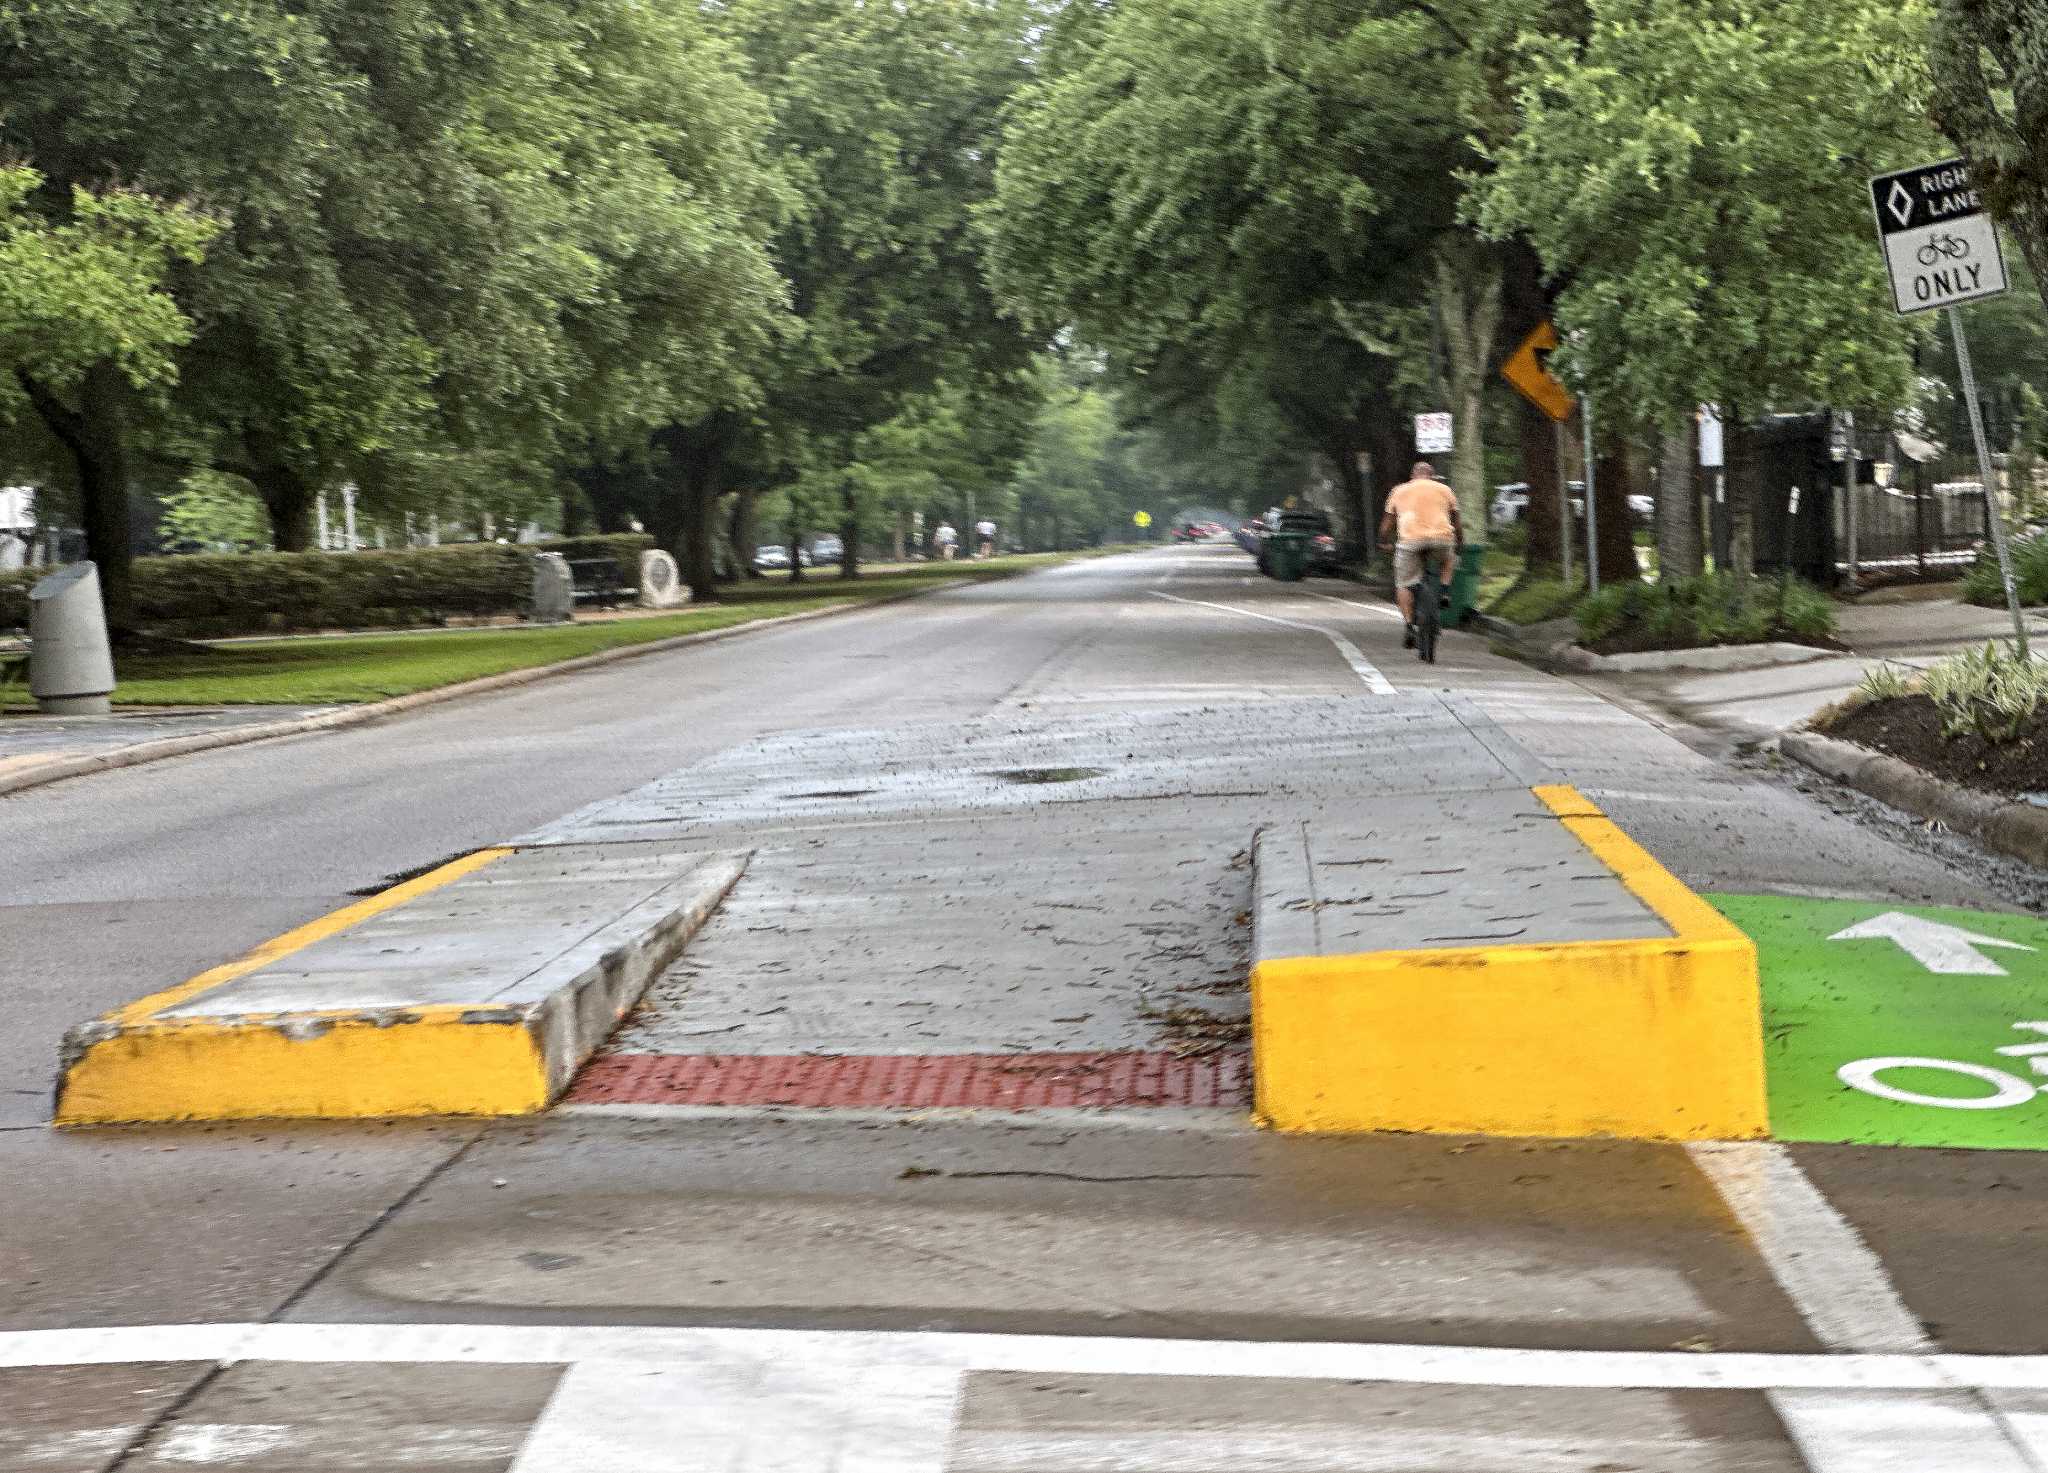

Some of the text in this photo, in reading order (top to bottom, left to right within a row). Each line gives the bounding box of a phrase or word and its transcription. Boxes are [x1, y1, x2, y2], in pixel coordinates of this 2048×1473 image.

[1920, 167, 1970, 193] RIGH
[1928, 190, 1981, 215] LANE
[1915, 263, 1981, 300] ONLY
